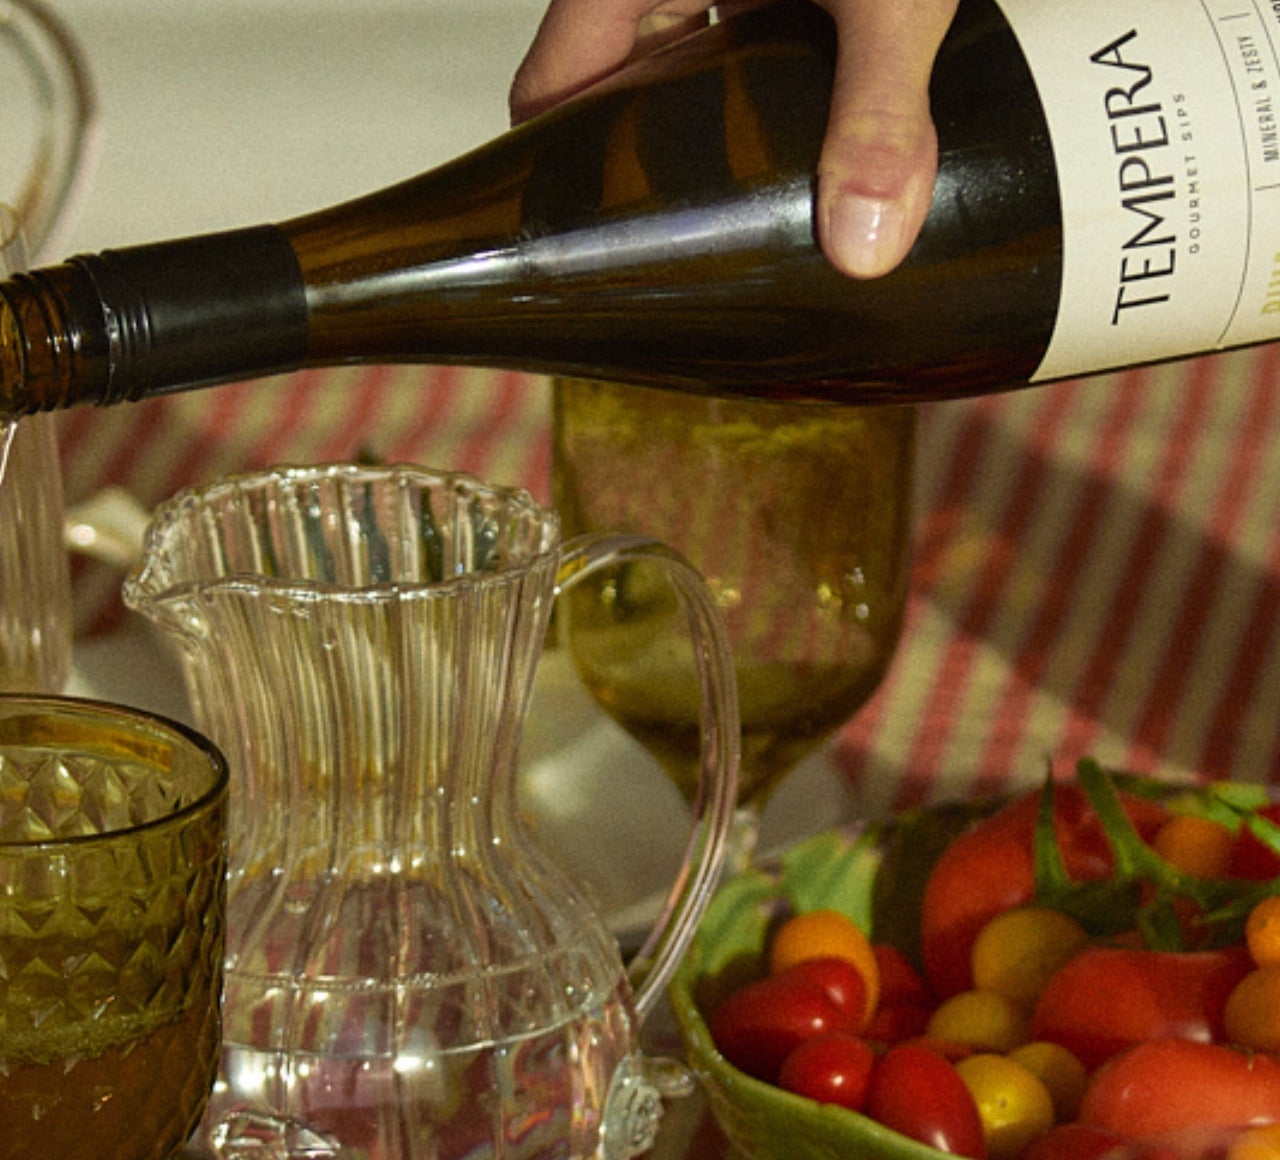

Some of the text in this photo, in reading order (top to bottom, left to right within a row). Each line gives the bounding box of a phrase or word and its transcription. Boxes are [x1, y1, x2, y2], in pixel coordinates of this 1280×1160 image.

[1089, 28, 1176, 326] TEMPERA
[1172, 93, 1201, 255] GOURMET SIPS
[1236, 35, 1280, 163] MINERAL & ZESTY
